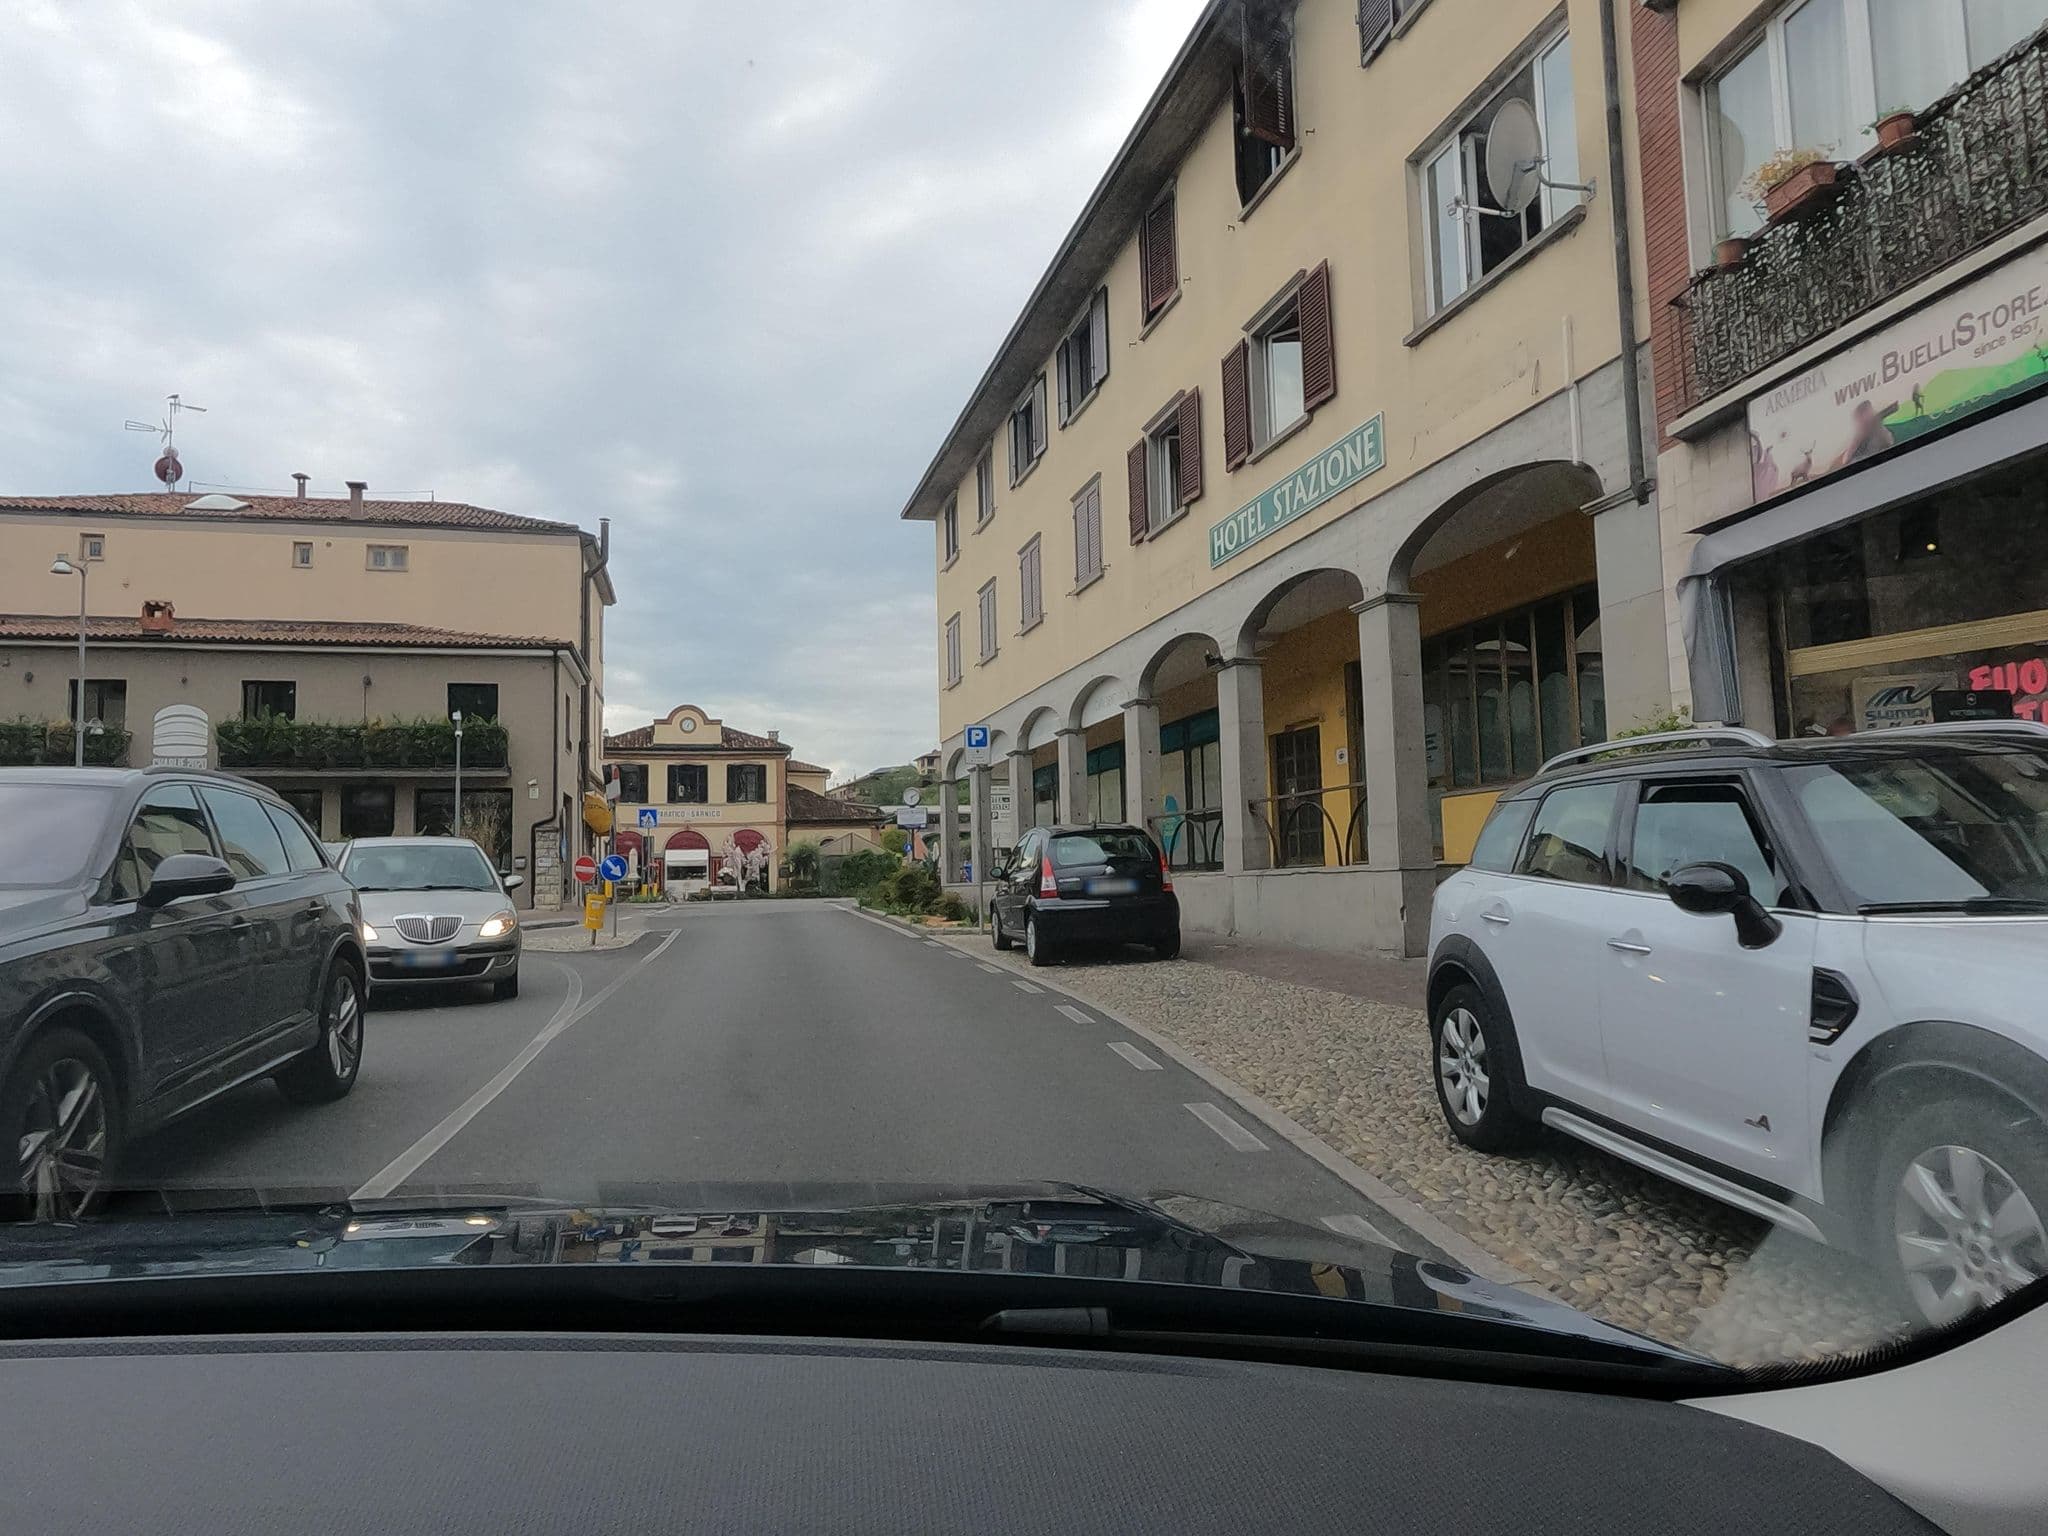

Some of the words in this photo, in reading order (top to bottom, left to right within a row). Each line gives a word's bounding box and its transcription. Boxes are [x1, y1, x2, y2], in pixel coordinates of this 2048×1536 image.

[1764, 370, 1828, 417] ARMERIA
[1212, 501, 1266, 560] HOTEL
[1272, 425, 1377, 523] STAZIONE
